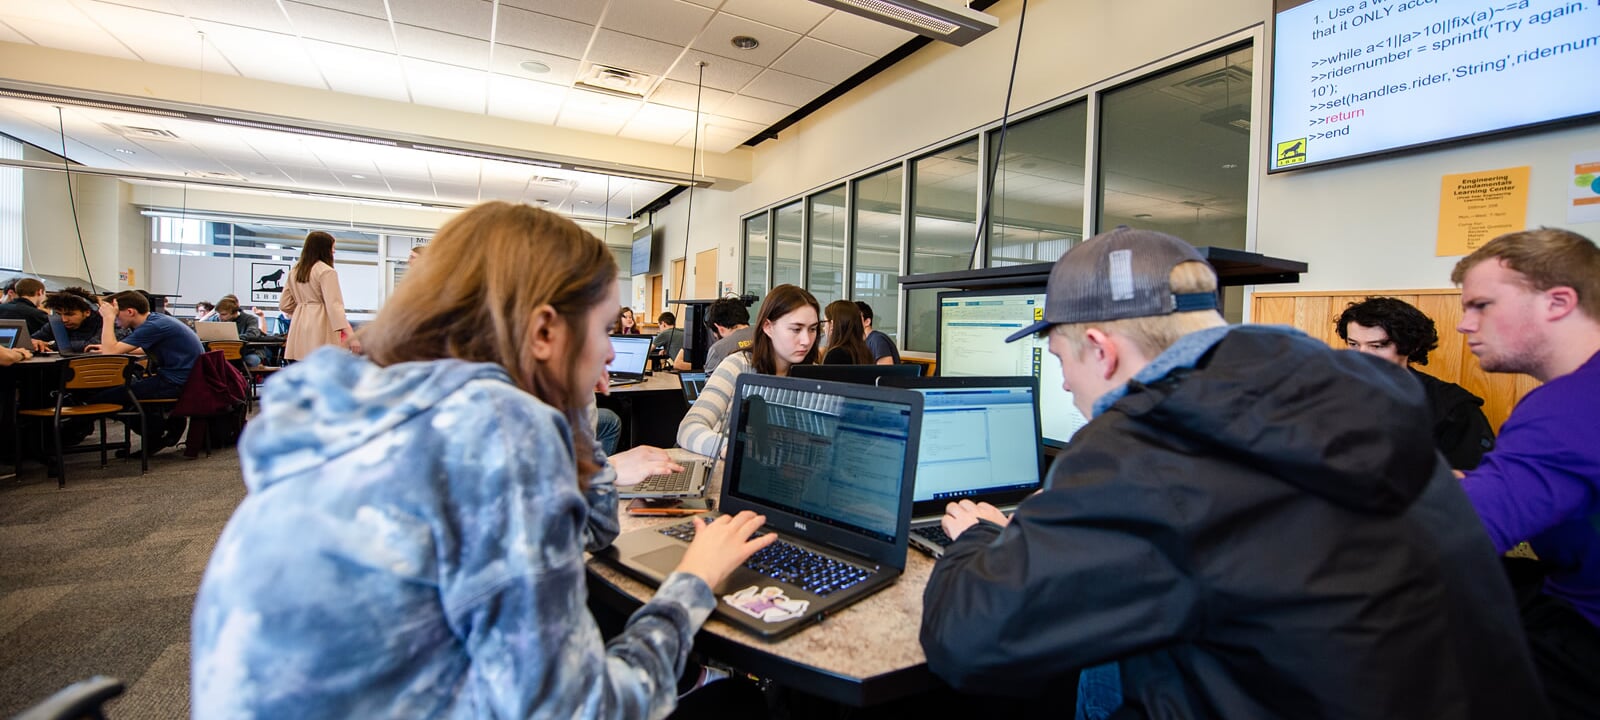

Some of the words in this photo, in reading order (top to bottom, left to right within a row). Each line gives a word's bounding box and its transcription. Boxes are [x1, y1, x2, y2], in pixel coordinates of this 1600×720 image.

[1313, 15, 1324, 25] 1.
[1328, 4, 1355, 20] Use
[1359, 1, 1367, 10] a
[1312, 24, 1336, 40] that
[1340, 20, 1348, 32] it
[1351, 4, 1394, 27] ONLY
[1311, 48, 1412, 82] >>ridernumber
[1417, 45, 1427, 53] =
[1432, 18, 1522, 51] sprintf('Try
[1528, 2, 1588, 24] again.
[1311, 47, 1362, 68] >>while
[1311, 84, 1338, 98] 10');
[1309, 108, 1365, 126] >>return
[1309, 125, 1350, 141] >>end
[1457, 180, 1512, 190] Fundamentals
[1462, 175, 1508, 184] Engineering
[1453, 188, 1487, 196] Learning
[794, 521, 807, 531] DELL
